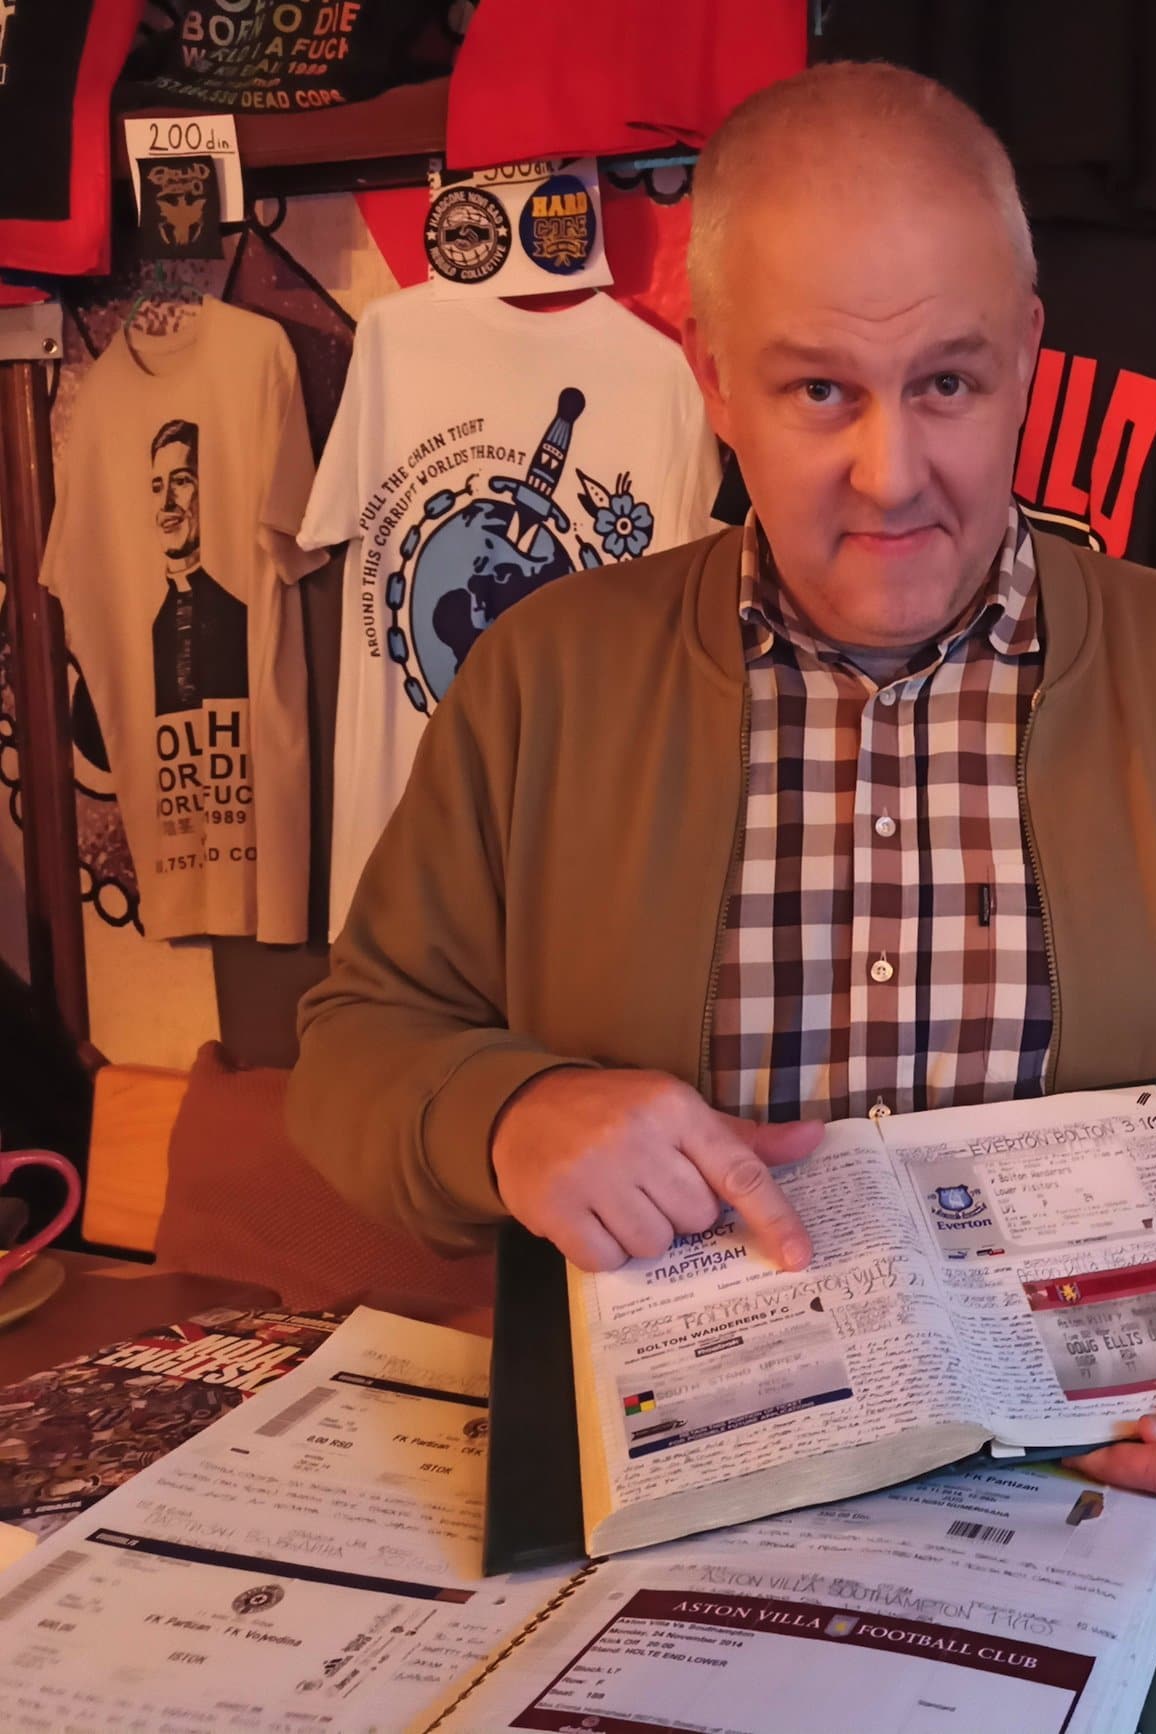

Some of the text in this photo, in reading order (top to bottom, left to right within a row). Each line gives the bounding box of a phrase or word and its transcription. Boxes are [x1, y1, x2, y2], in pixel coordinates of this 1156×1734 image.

[314, 2, 360, 36] DIE
[241, 90, 290, 108] DEAD
[149, 123, 202, 151] 200
[470, 444, 527, 466] THROAT
[359, 418, 486, 531] PULL THE CHAIN TIGHT
[373, 484, 419, 548] CORRUPT
[362, 550, 383, 587] THIS
[361, 591, 382, 658] AROUND
[968, 1134, 1049, 1157] EVERTON
[1054, 1122, 1115, 1145] BOLTON
[668, 1222, 736, 1251] ЛАДОСТ
[936, 1216, 993, 1232] Everton
[655, 1245, 748, 1281] ПАРТИЗАН
[637, 1334, 688, 1355] BOLTON
[690, 1312, 768, 1339] WANDERERS
[1105, 1331, 1144, 1351] ELLIS
[411, 1437, 450, 1451] Partizan
[964, 1471, 1040, 1492] FK Partizan
[666, 1632, 718, 1645] November
[718, 1638, 744, 1648] 2014
[672, 1600, 1039, 1669] ASTON VILLA FOOTBALL CLUB
[624, 1648, 662, 1659] HOLTE
[661, 1652, 687, 1661] END
[686, 1655, 729, 1668] LOWER
